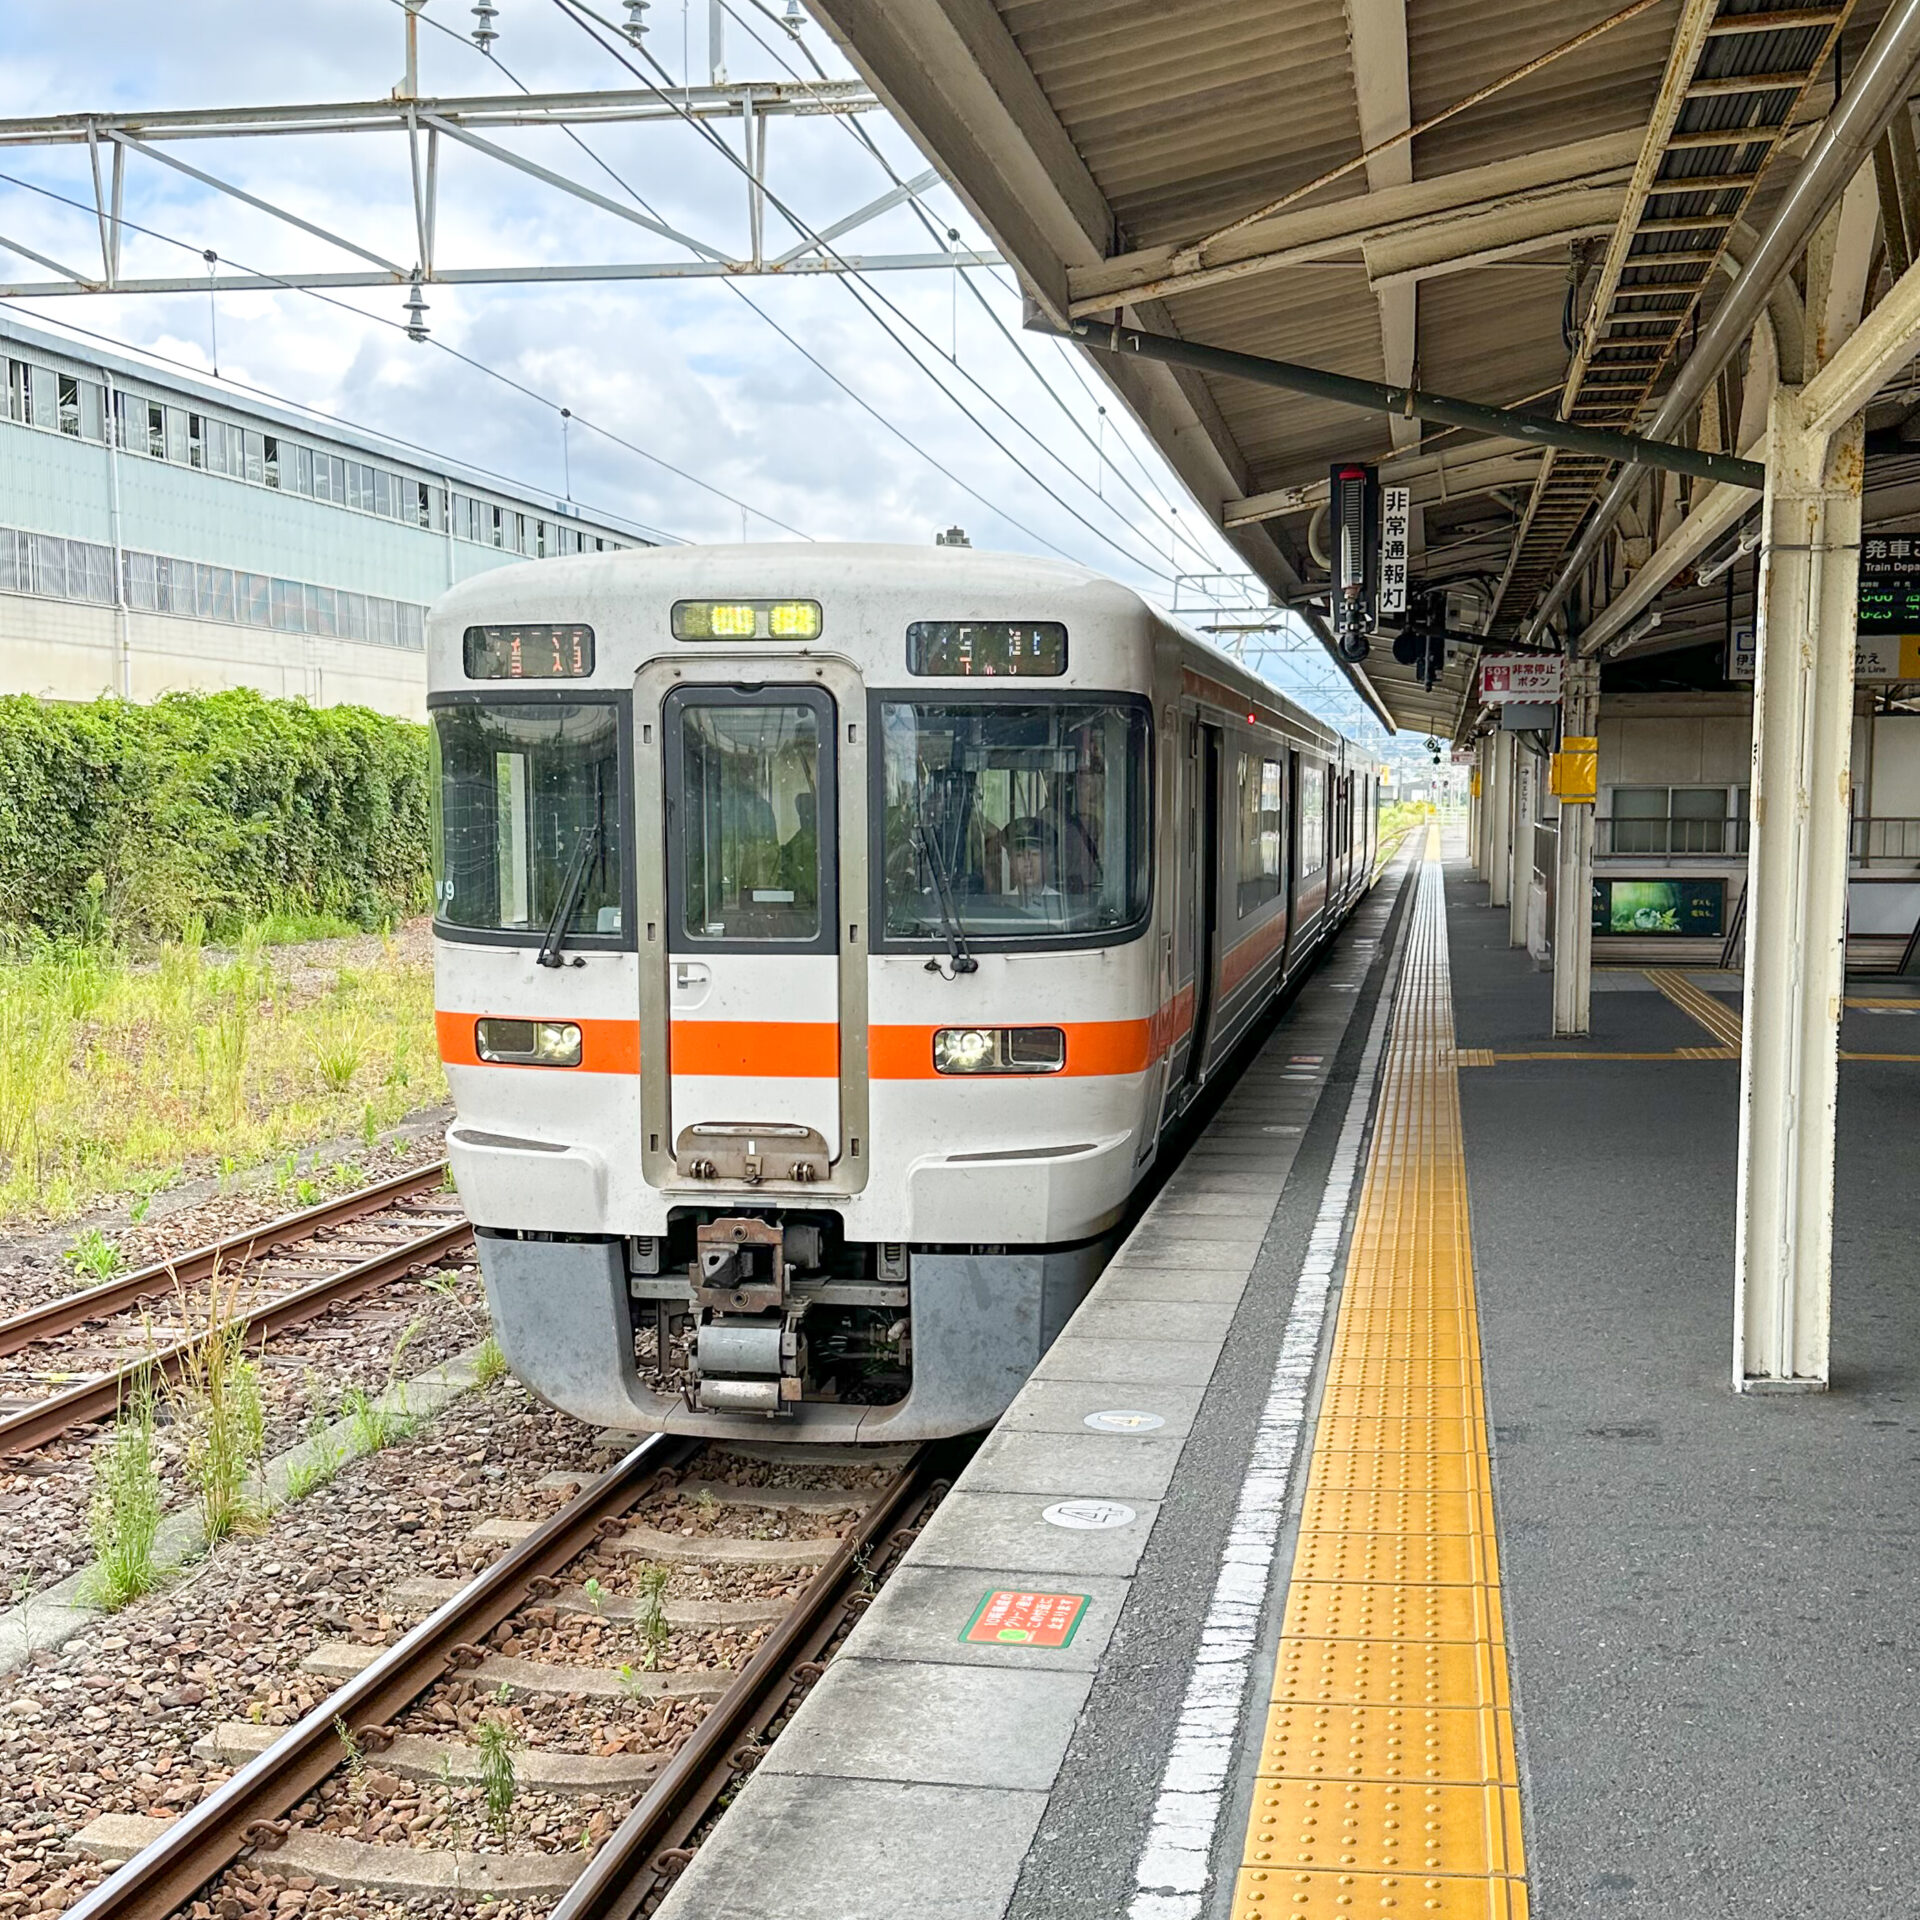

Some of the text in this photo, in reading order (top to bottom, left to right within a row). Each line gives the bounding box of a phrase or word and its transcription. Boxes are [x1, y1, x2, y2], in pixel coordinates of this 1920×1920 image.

[1383, 491, 1407, 608] 非常通報灯
[1865, 563, 1891, 572] Train
[1487, 667, 1508, 676] SOS
[1512, 664, 1556, 675] 非常停止
[1518, 676, 1551, 687] ボタン
[1427, 740, 1435, 749] 6
[1057, 1506, 1124, 1524] 4
